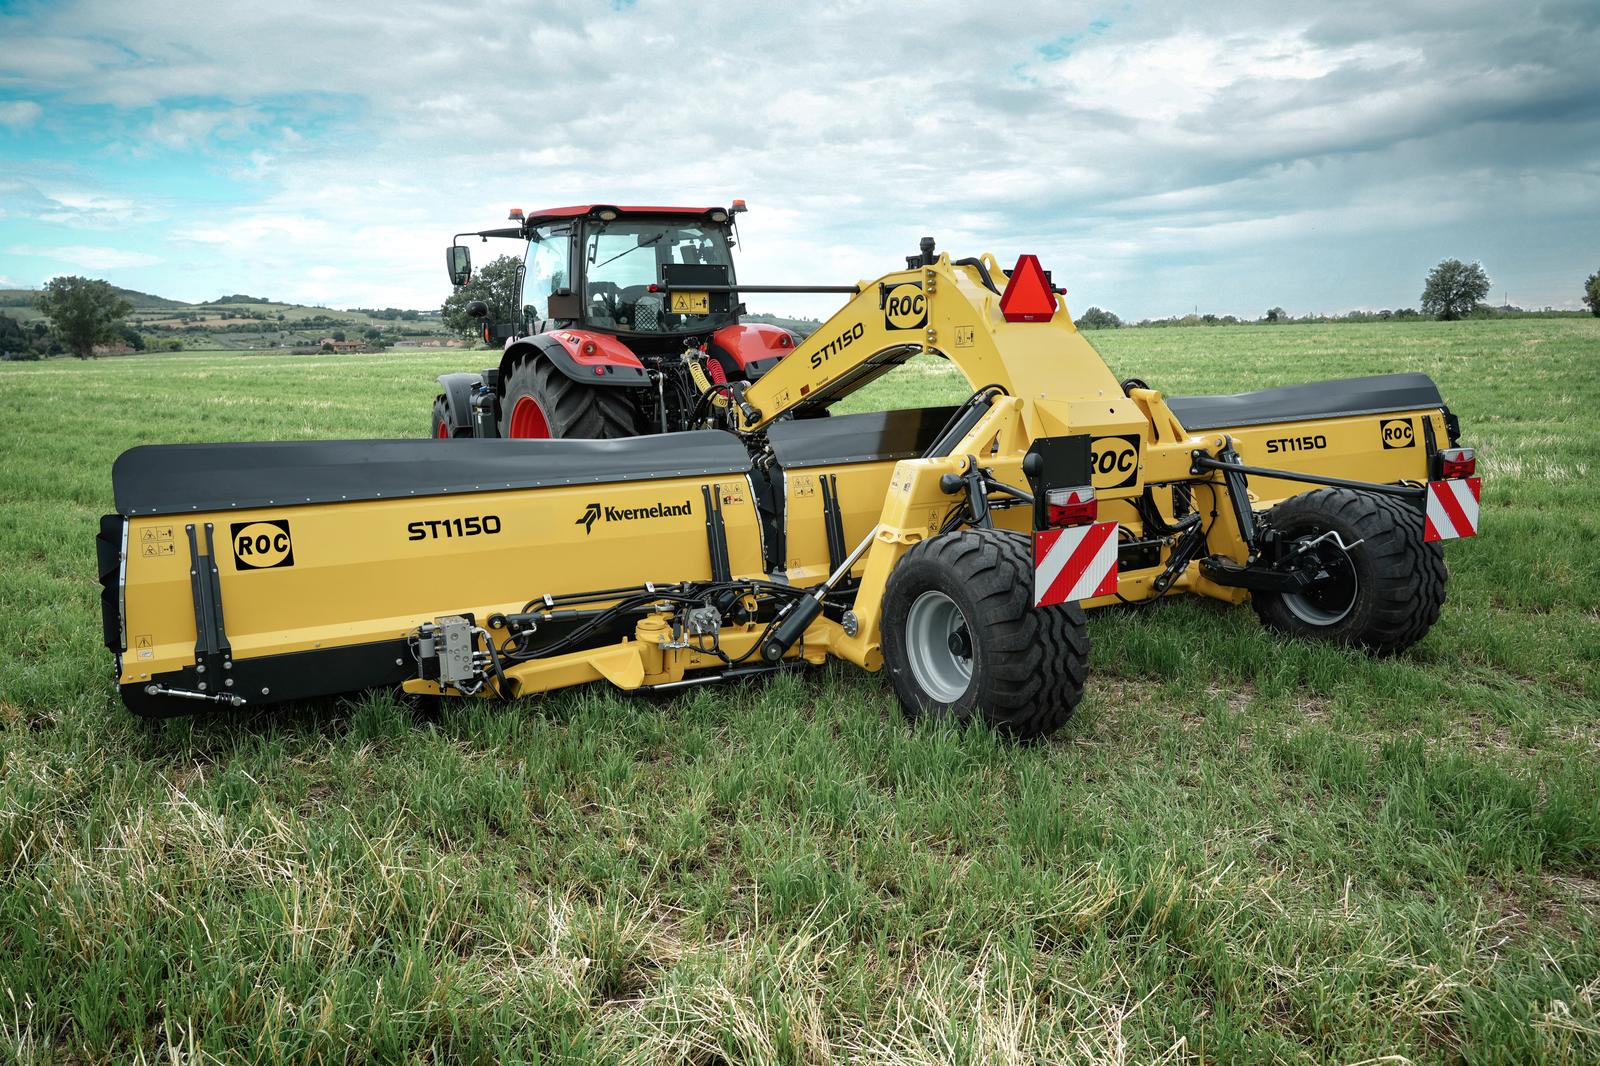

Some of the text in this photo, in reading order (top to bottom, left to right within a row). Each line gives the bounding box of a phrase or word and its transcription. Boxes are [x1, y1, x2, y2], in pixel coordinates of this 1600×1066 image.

[888, 295, 925, 317] ROC
[810, 322, 864, 370] ST1150
[1382, 426, 1413, 440] ROC
[1266, 435, 1327, 454] ST1150
[604, 500, 692, 522] Kverneland
[407, 515, 501, 541] ST1150
[238, 533, 288, 556] ROC
